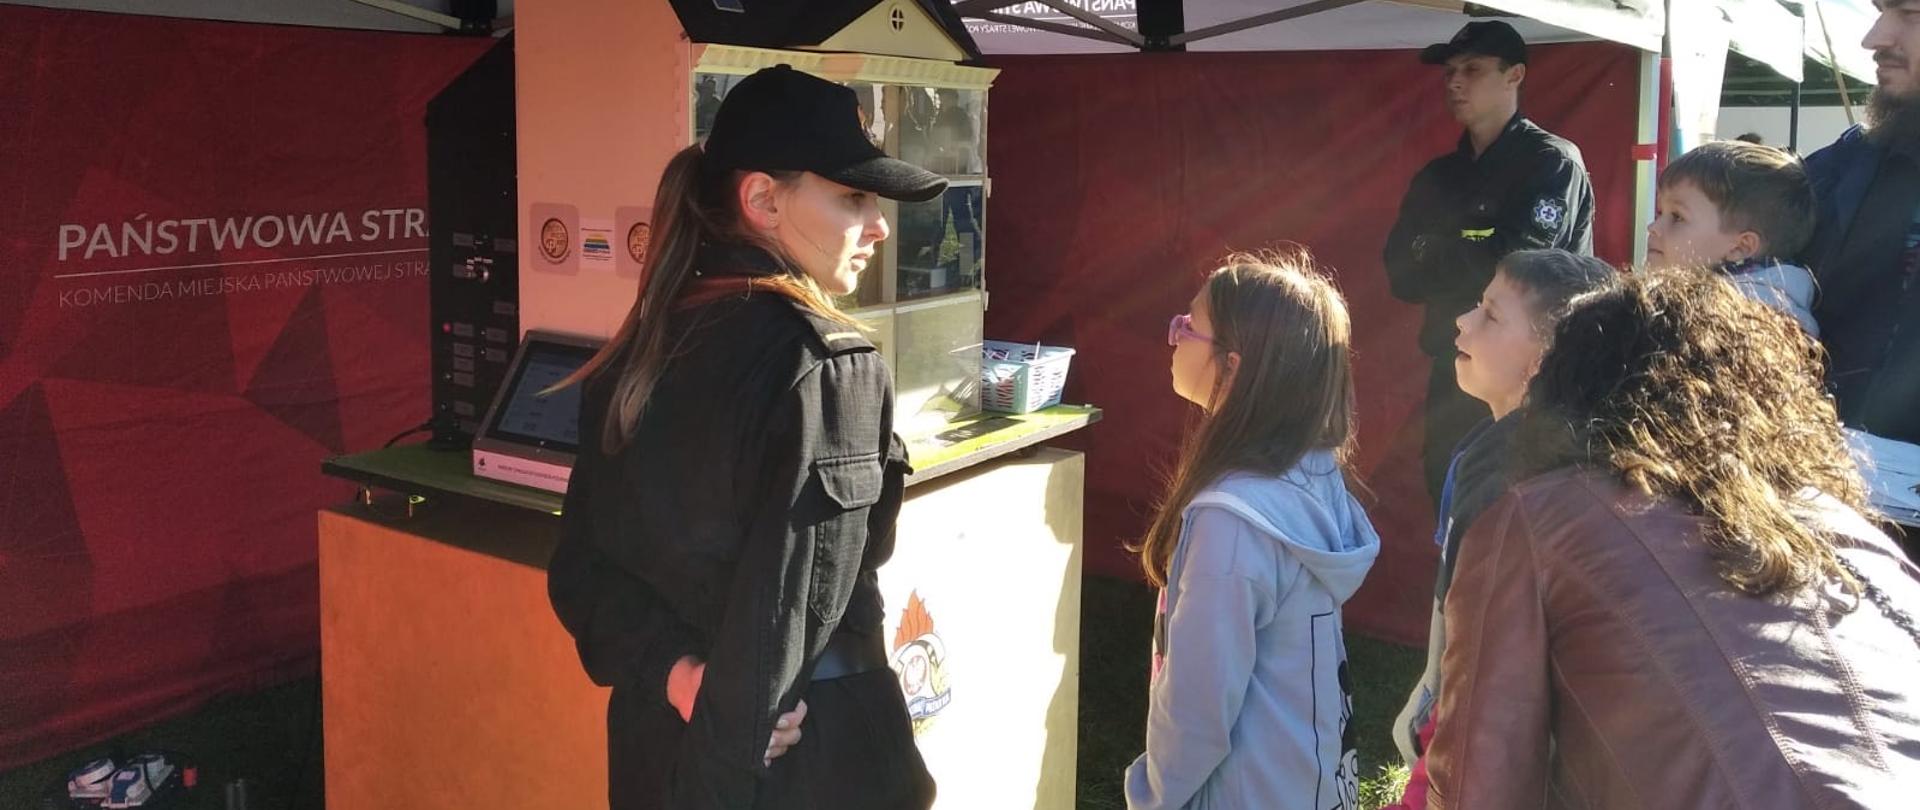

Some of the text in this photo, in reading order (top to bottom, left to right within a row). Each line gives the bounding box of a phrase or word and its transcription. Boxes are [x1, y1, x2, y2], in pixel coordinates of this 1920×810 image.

[58, 208, 430, 261] PAŃSTWOWA STR
[59, 281, 173, 308] KOMENDA
[178, 273, 261, 297] MIEJSKA
[264, 263, 391, 289] PAŃSTWOWEJ
